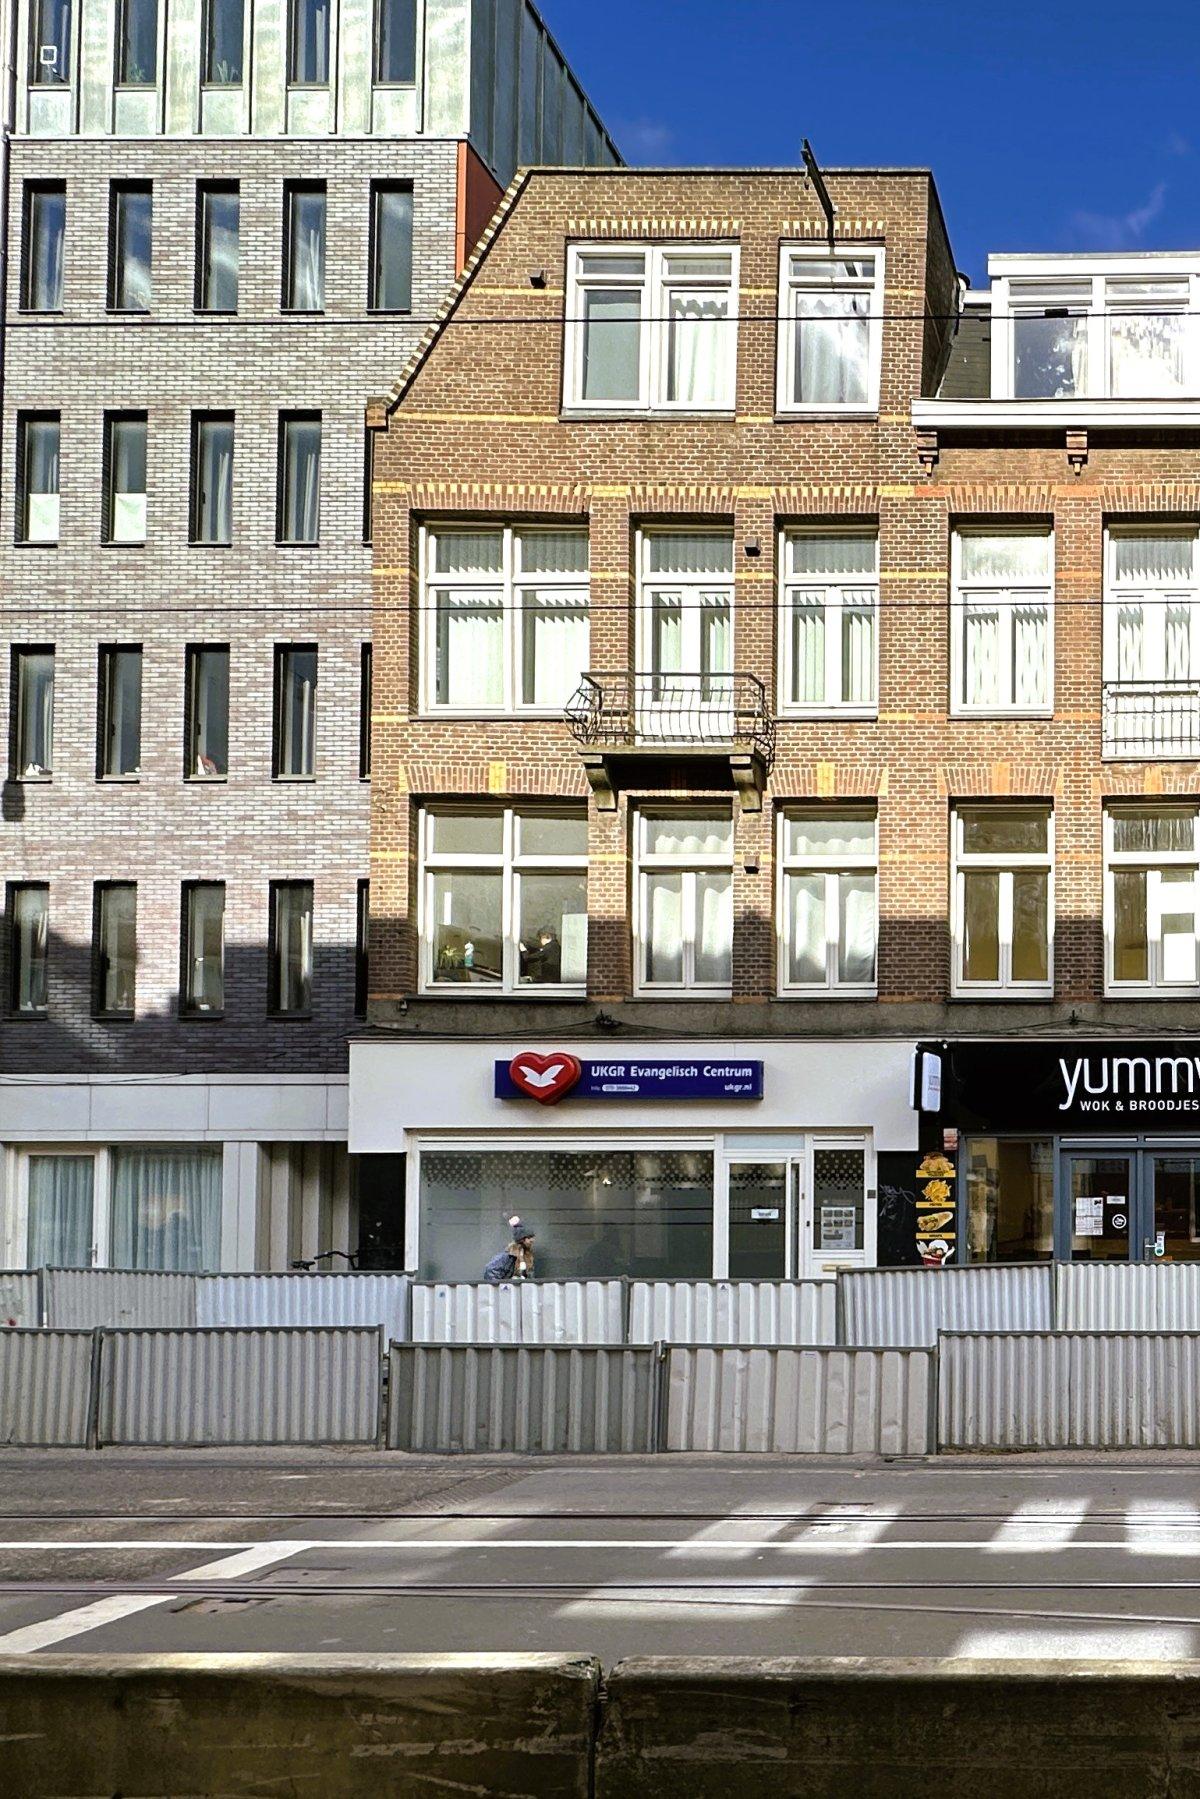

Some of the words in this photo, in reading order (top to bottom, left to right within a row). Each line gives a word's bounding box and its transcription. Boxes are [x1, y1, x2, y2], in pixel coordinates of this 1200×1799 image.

[591, 1065, 626, 1077] UKGR
[630, 1065, 698, 1080] Evangelisch
[703, 1065, 753, 1077] Centrum
[724, 1083, 753, 1093] ukgr.nl
[1079, 1100, 1110, 1112] WOK
[1115, 1100, 1124, 1112] &
[1129, 1099, 1200, 1111] BROODJES
